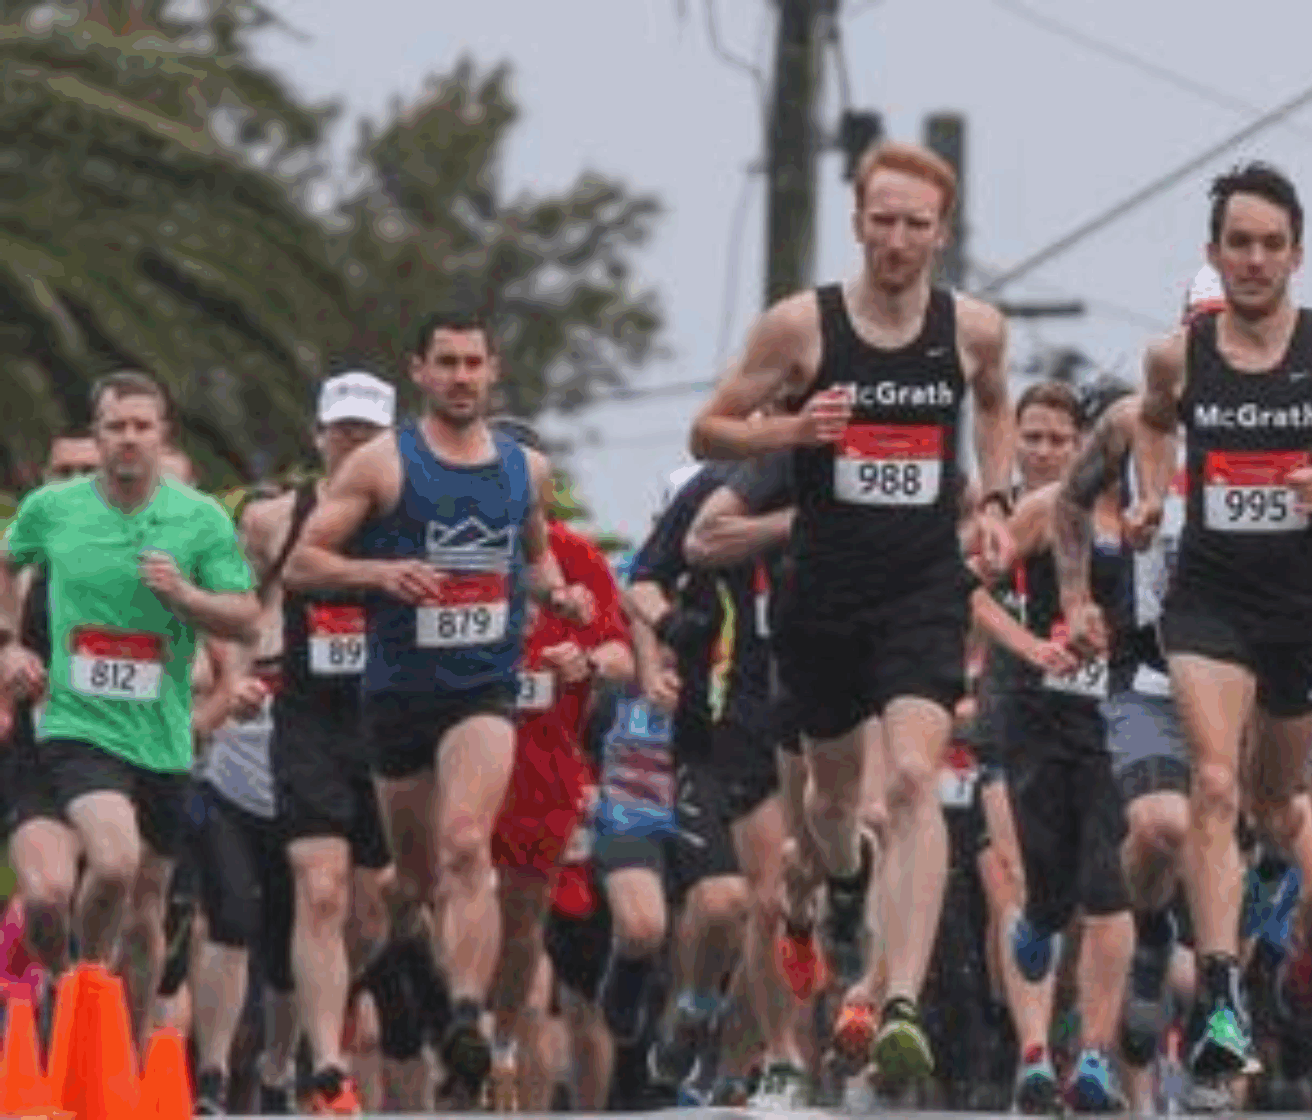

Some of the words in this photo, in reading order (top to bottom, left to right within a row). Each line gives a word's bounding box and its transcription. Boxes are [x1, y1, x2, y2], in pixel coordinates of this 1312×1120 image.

[859, 464, 921, 495] 988
[1226, 490, 1287, 522] 995
[437, 607, 491, 639] 879
[91, 660, 135, 691] 812
